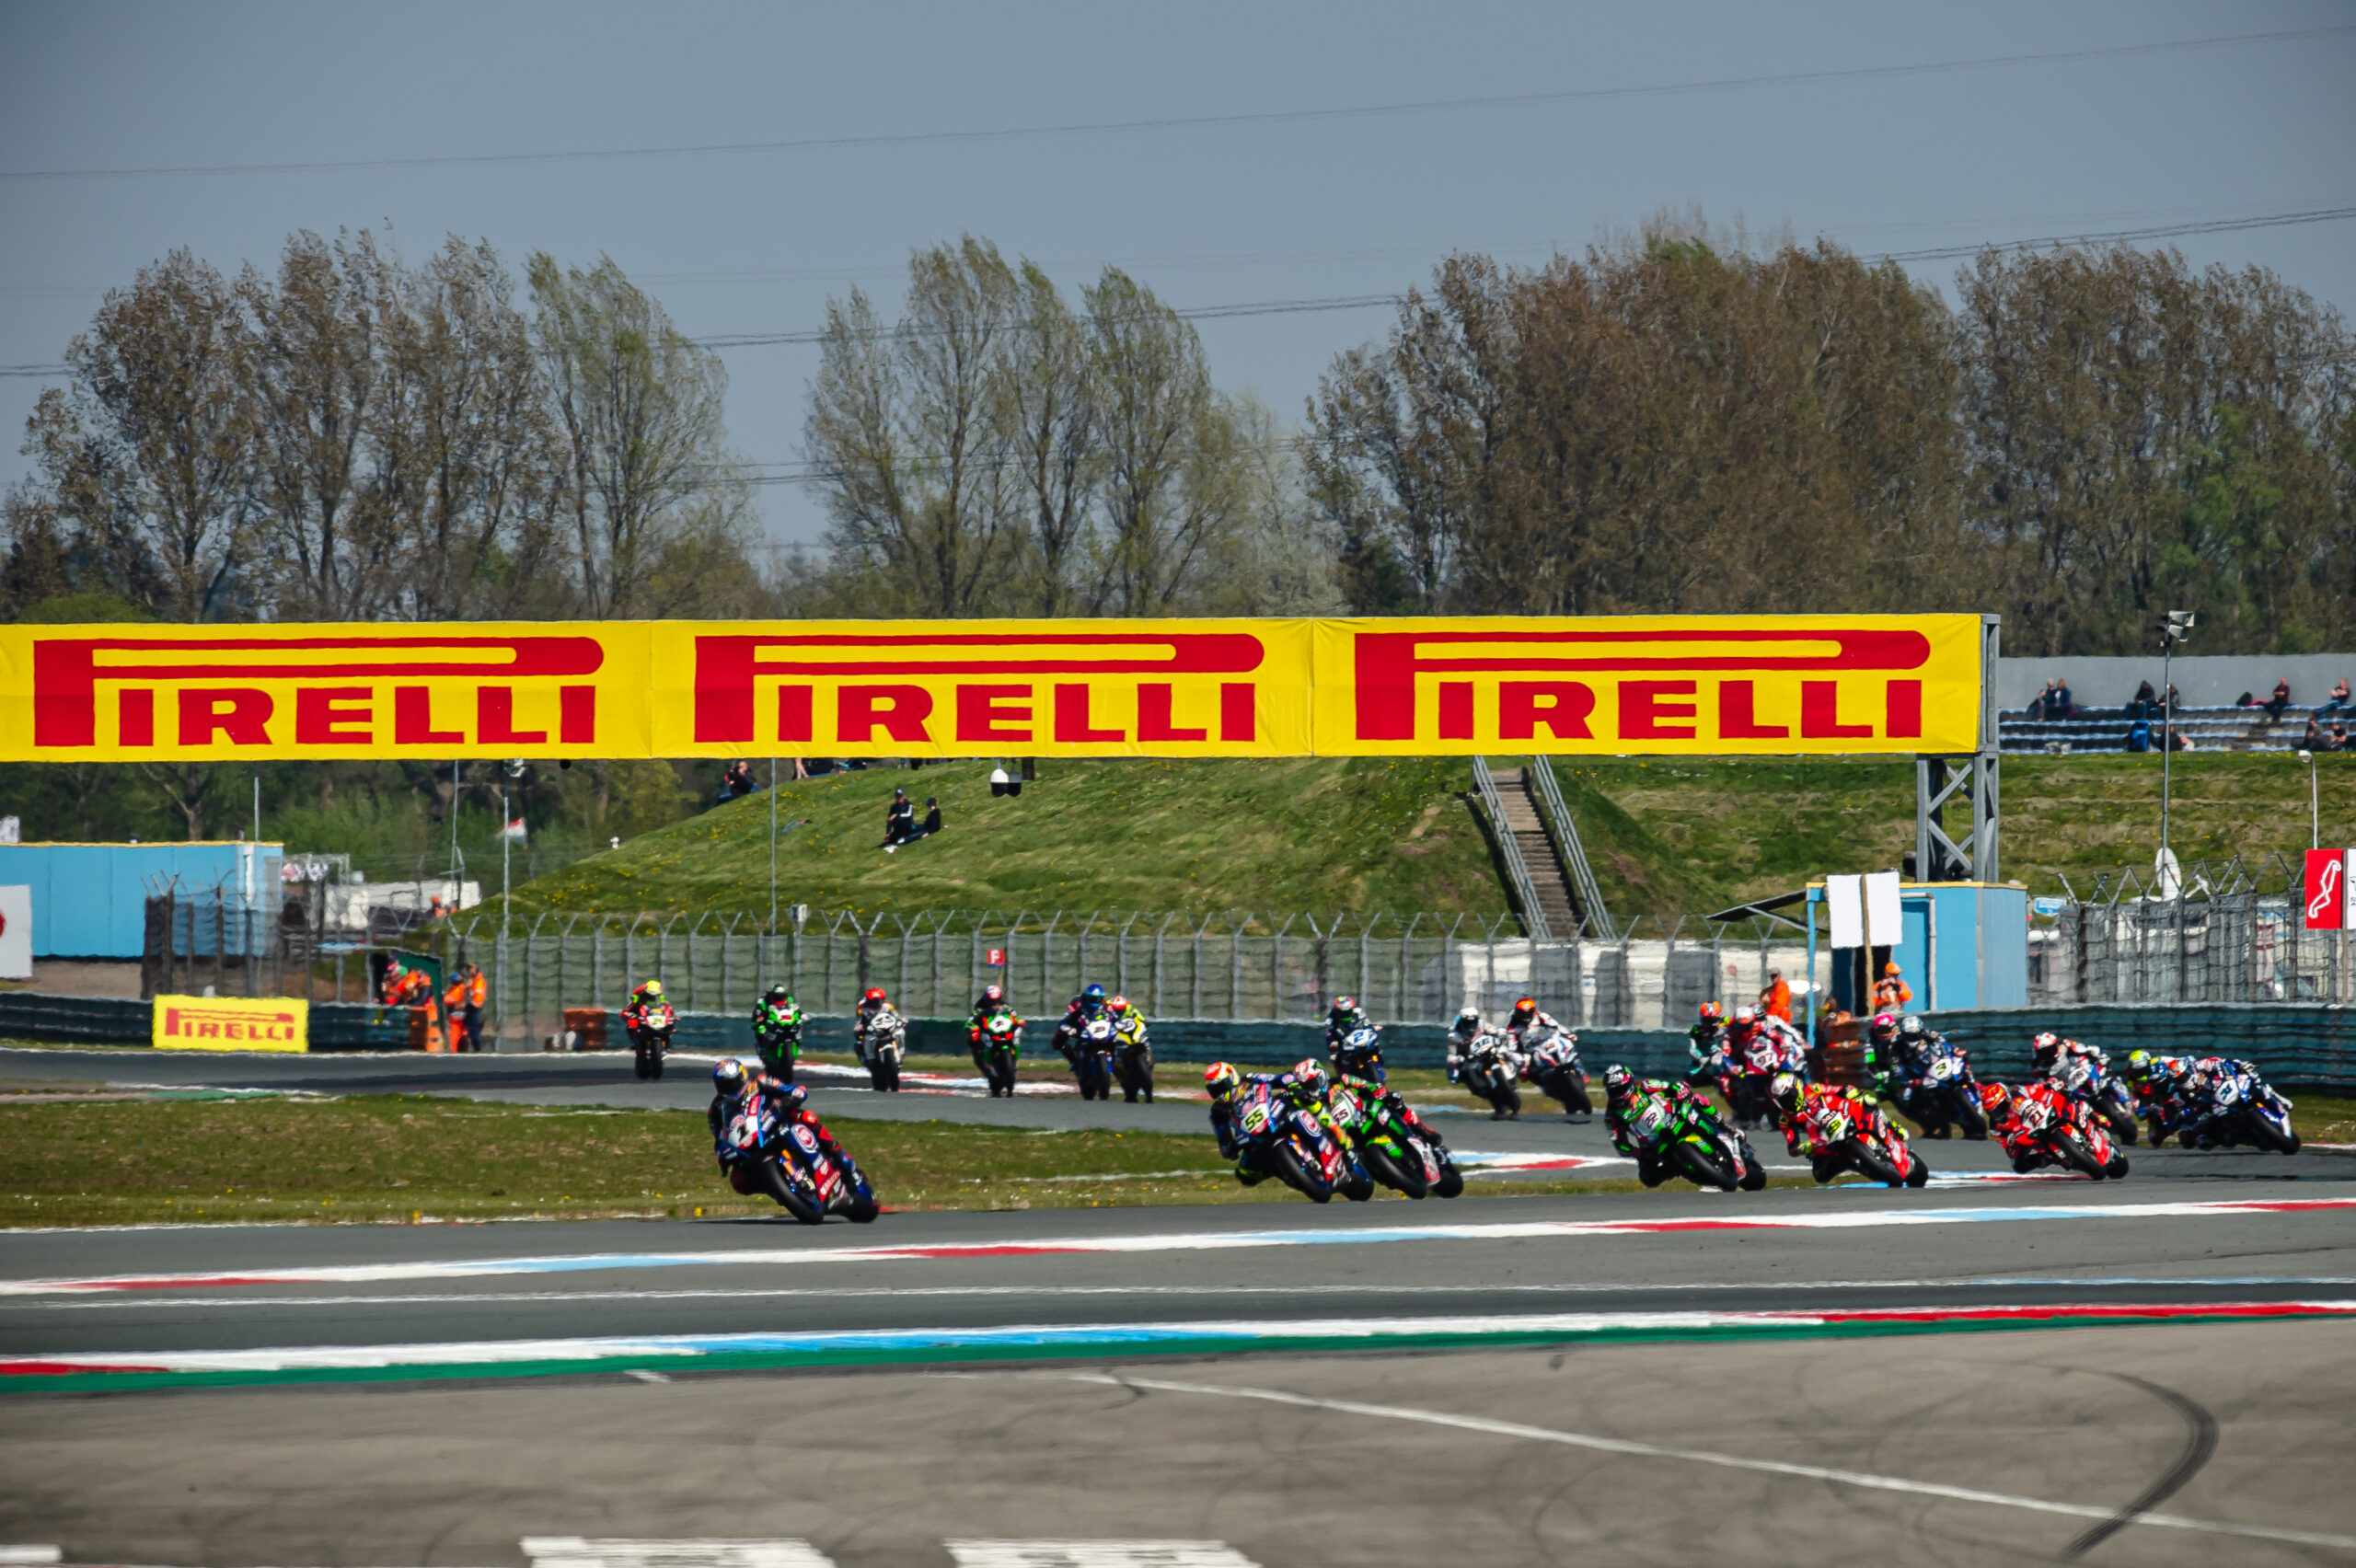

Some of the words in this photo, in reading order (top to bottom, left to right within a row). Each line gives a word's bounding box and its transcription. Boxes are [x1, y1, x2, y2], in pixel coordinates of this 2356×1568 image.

[33, 636, 604, 746] PIRELLI
[695, 633, 1265, 743] PIRELLI
[1355, 630, 1931, 740] PIRELLI
[166, 1008, 294, 1041] PIRELLI
[1244, 1107, 1265, 1132] 55
